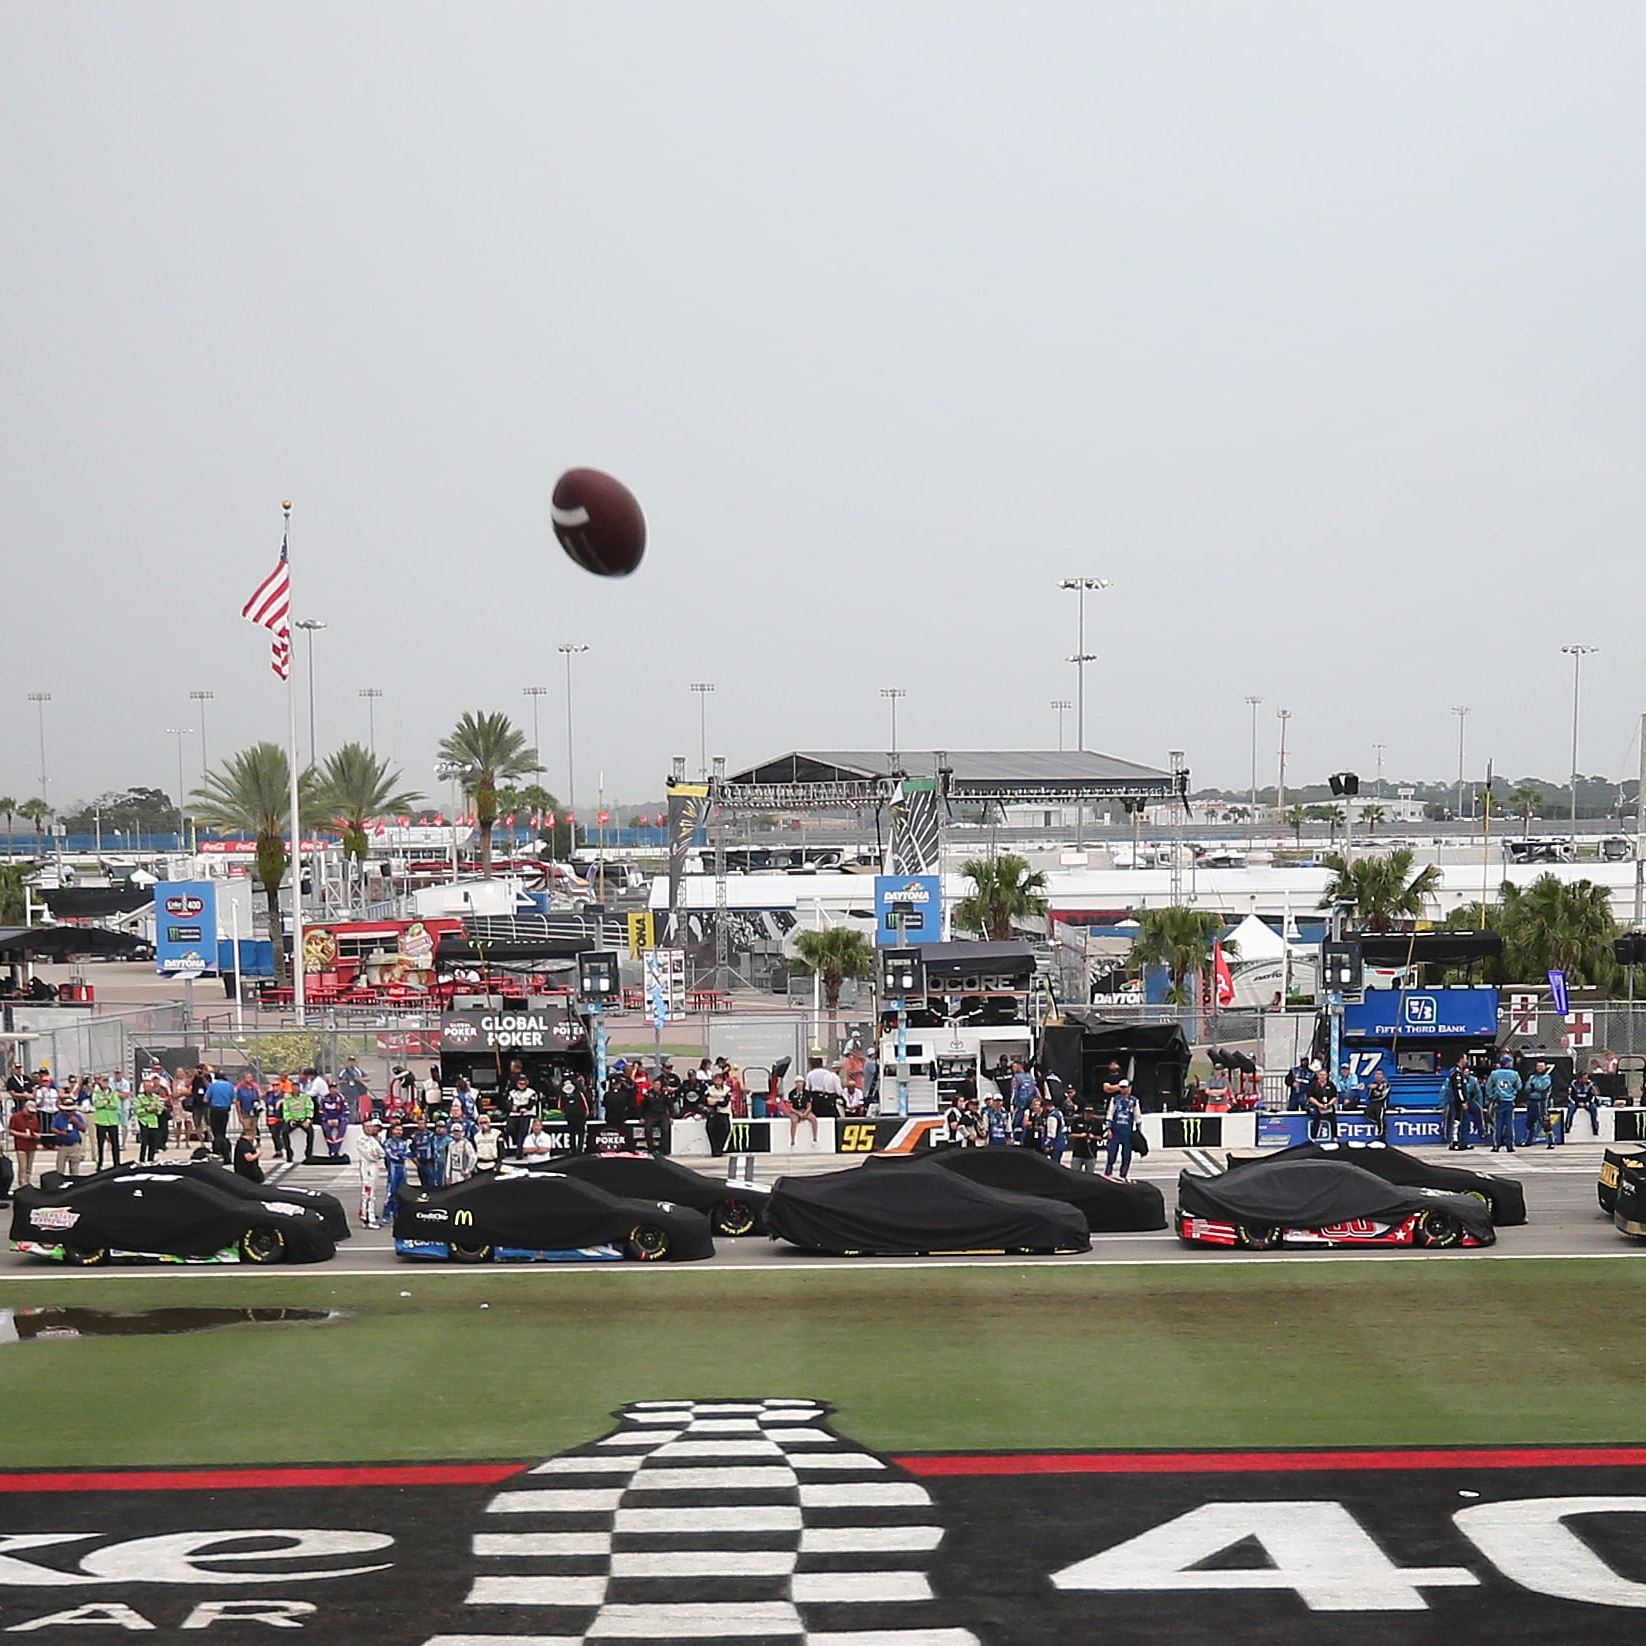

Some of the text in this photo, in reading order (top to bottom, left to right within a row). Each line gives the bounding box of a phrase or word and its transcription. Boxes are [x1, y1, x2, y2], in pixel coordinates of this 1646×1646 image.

[883, 889, 931, 904] DAYTONA
[164, 958, 206, 969] DAYTONA
[481, 1016, 549, 1031] GLOBAL
[1405, 1024, 1436, 1034] THIRD
[1438, 1023, 1467, 1034] BANK
[444, 1027, 478, 1038] POKER
[1347, 1053, 1383, 1076] 17
[1394, 1121, 1441, 1137] THIR
[594, 1136, 626, 1147] POKER
[841, 1125, 877, 1152] 95
